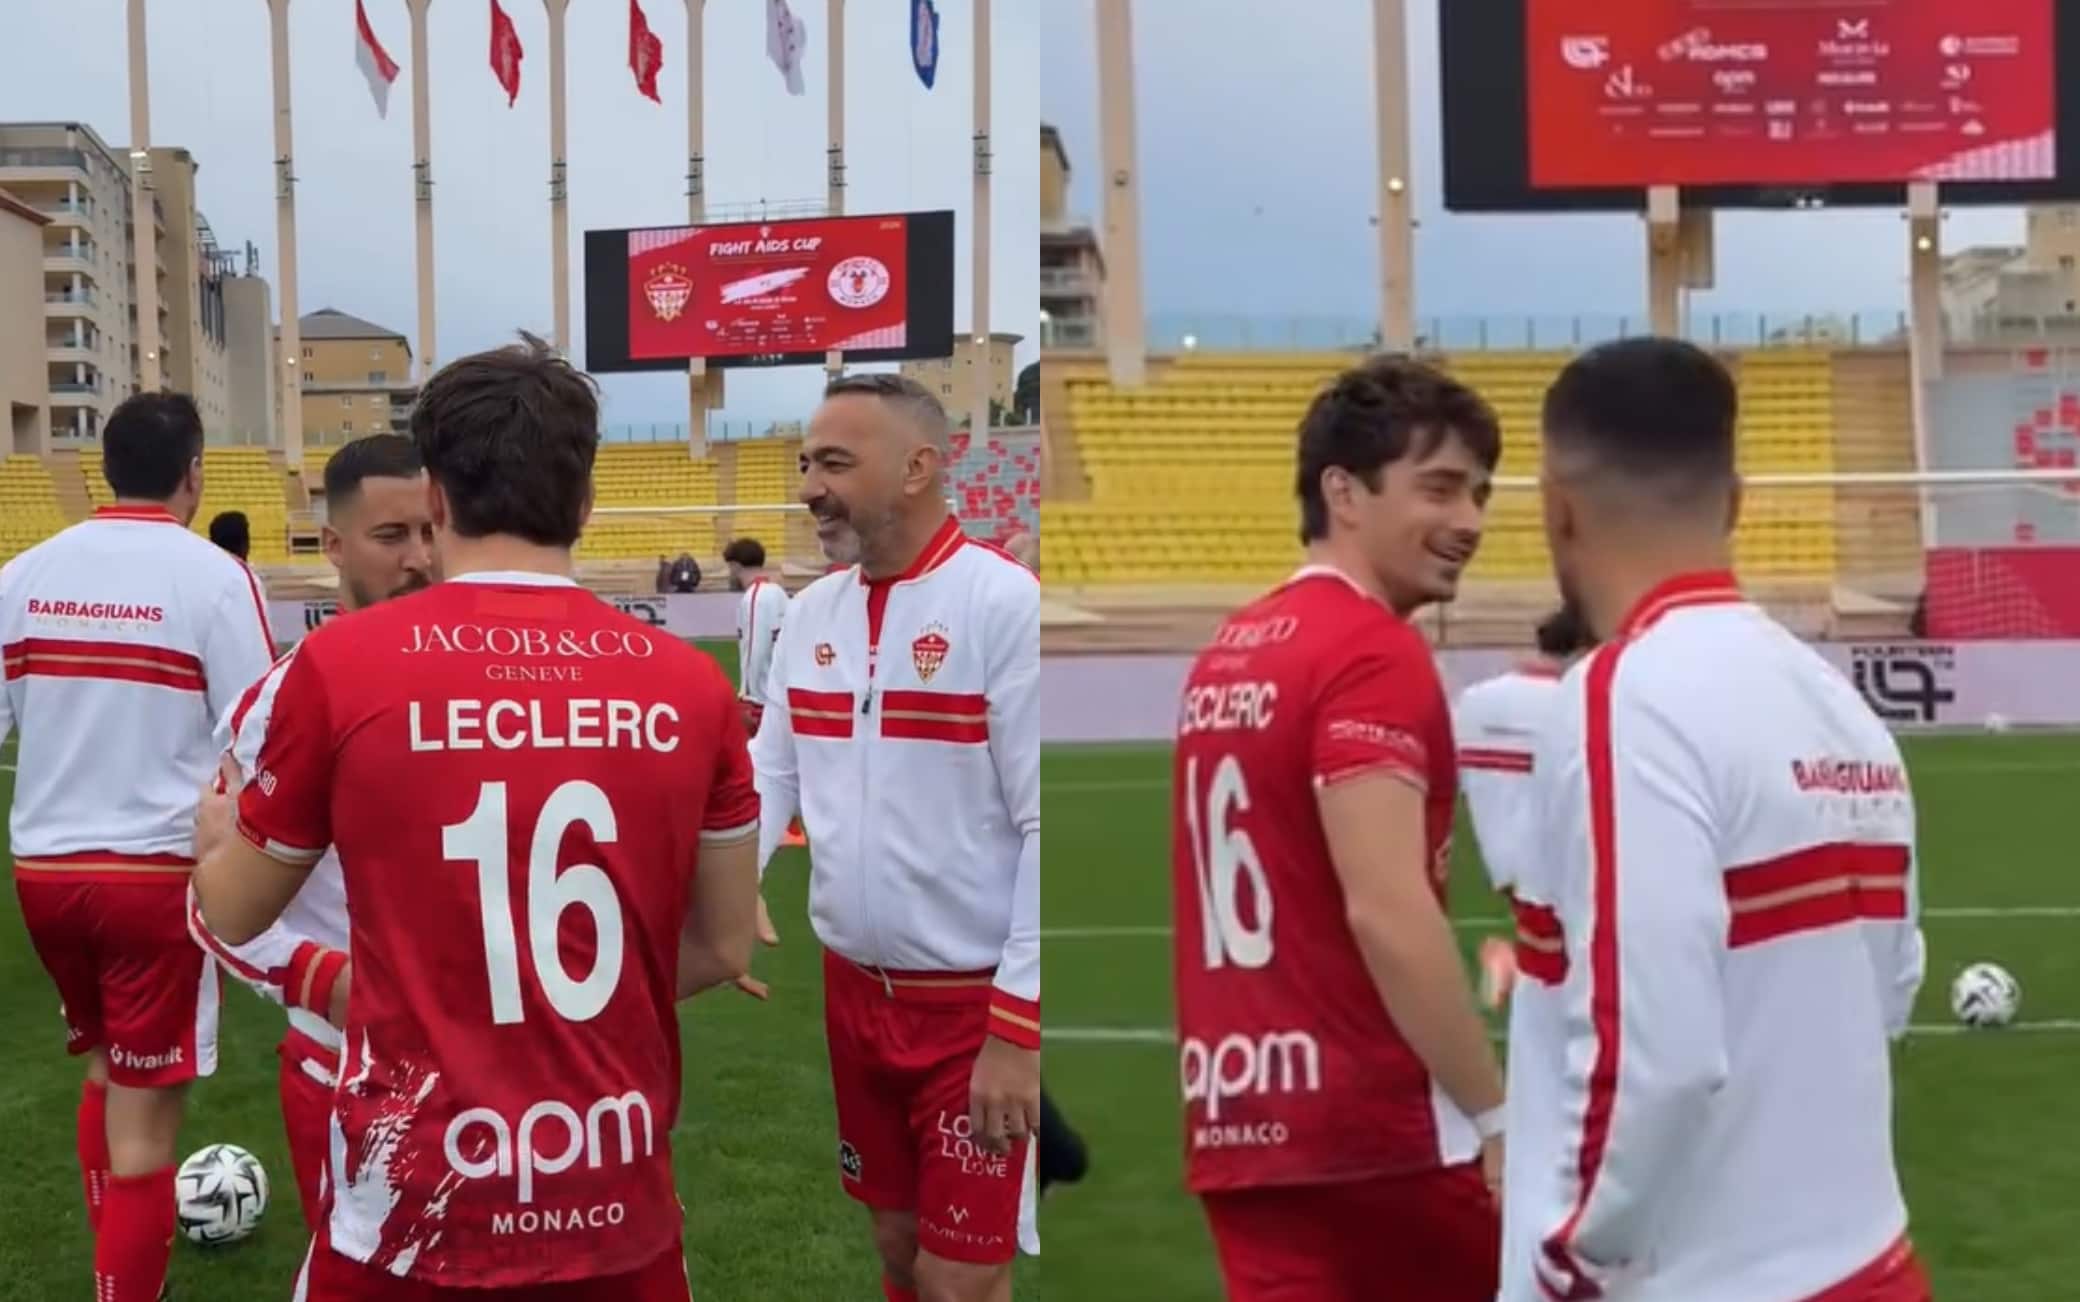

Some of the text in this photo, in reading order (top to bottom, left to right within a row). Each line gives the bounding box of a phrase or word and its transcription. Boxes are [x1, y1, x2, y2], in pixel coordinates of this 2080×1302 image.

[709, 237, 822, 256] FIGHT AIDS CUP
[27, 598, 163, 622] BARBAGIUANS
[485, 664, 583, 682] GENEVE
[409, 699, 680, 752] LECLERC
[1187, 754, 1274, 969] 16
[441, 779, 625, 1025] 16
[1181, 1030, 1320, 1120] apm
[443, 1090, 654, 1204] apm
[1195, 1122, 1288, 1148] MONACO
[961, 1157, 1008, 1177] LOVE
[492, 1202, 625, 1234] MONACO
